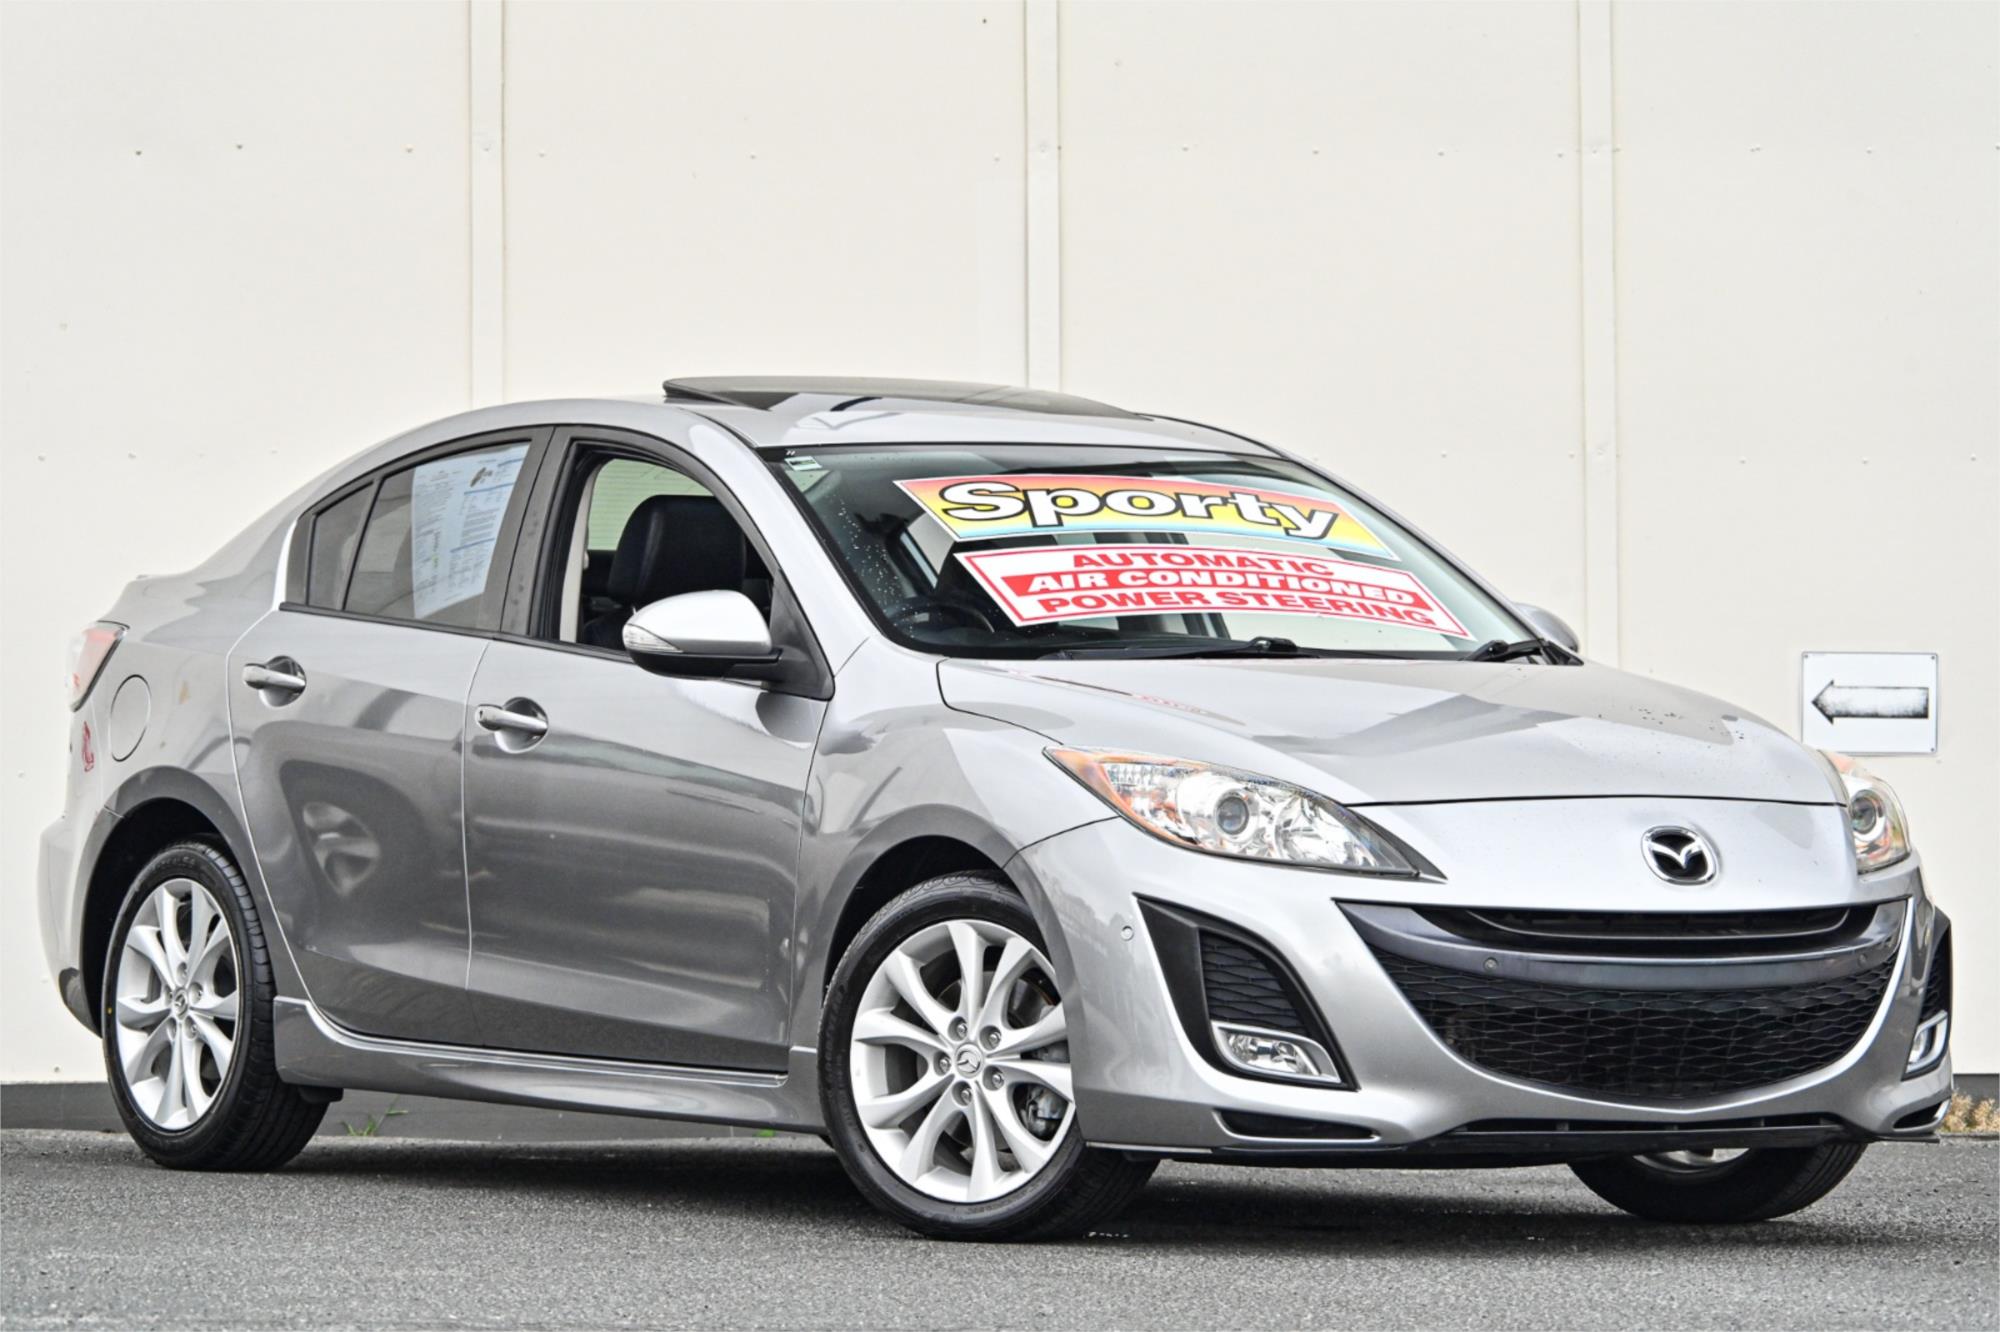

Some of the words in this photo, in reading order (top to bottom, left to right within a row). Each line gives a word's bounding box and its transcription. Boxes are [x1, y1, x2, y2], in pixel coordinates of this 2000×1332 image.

[939, 480, 1339, 540] Sporty
[1073, 553, 1334, 576] AUTOMATIC
[1028, 570, 1109, 593] AIR
[1118, 570, 1415, 606] CONDITIONED
[1036, 591, 1212, 613] POWER
[1216, 591, 1436, 626] STEERING
